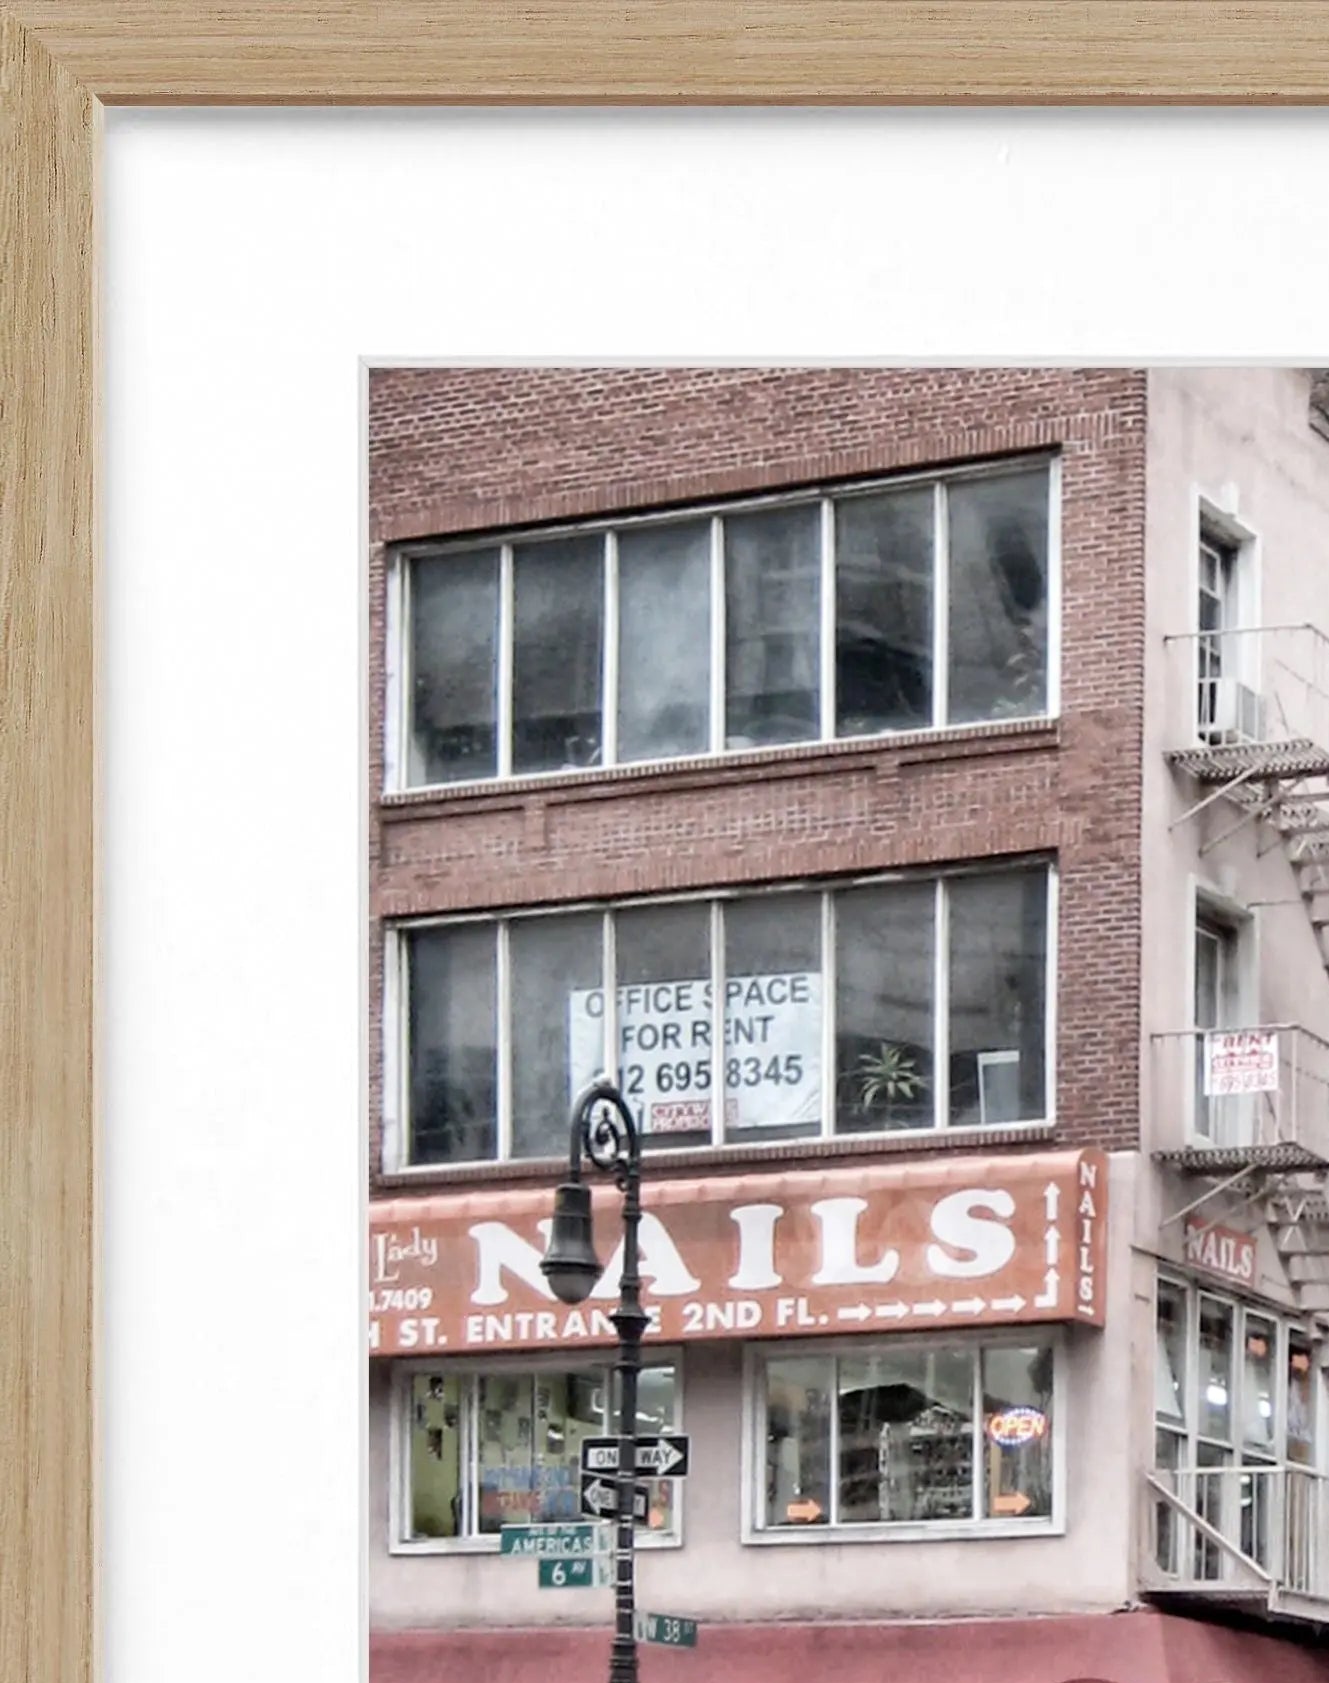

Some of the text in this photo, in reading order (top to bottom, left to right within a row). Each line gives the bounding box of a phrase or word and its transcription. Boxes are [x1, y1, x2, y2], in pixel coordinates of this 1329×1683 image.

[621, 1022, 682, 1053] FOR
[593, 1054, 803, 1095] 12 695 8345
[1078, 1161, 1098, 1300] NAILS
[467, 1186, 1017, 1307] NAILS
[1186, 1223, 1254, 1279] NAILS
[399, 1317, 448, 1348] ST.
[466, 1305, 662, 1344] ENTRANE
[682, 1300, 763, 1334] 2ND
[777, 1297, 829, 1328] FL.
[990, 1414, 1045, 1437] OPEN
[595, 1449, 673, 1466] ON WAY
[511, 1536, 592, 1554] AMERICAS
[551, 1561, 567, 1586] 6
[663, 1619, 680, 1643] 38
